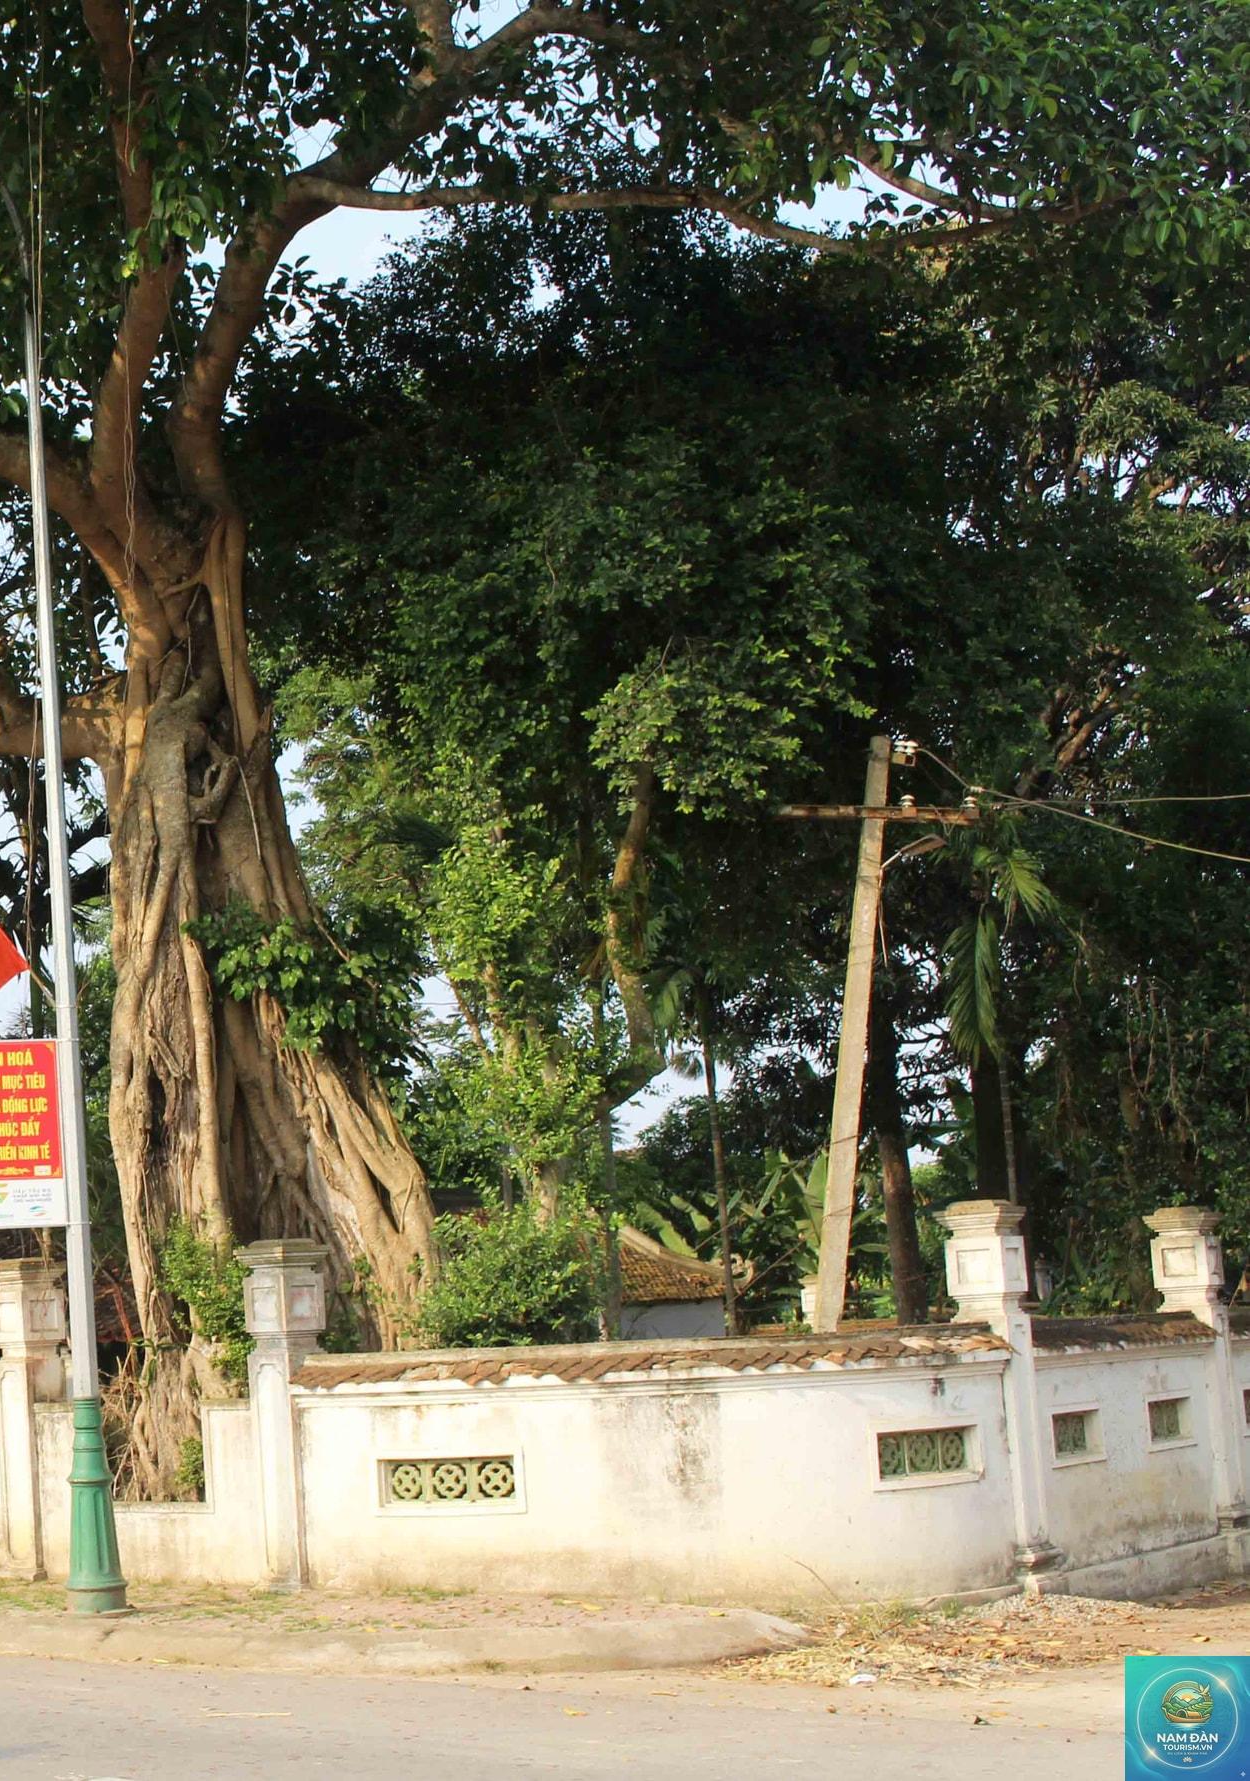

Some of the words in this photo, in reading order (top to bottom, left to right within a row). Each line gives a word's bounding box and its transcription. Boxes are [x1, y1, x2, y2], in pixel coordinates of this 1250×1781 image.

[7, 1048, 34, 1067] HOÁ
[2, 1074, 23, 1093] MỤC
[25, 1072, 46, 1089] TIÊU
[2, 1096, 28, 1116] ĐỘNG
[30, 1096, 48, 1115] LỰC
[17, 1145, 39, 1160] KINH
[40, 1140, 51, 1160] TẾ
